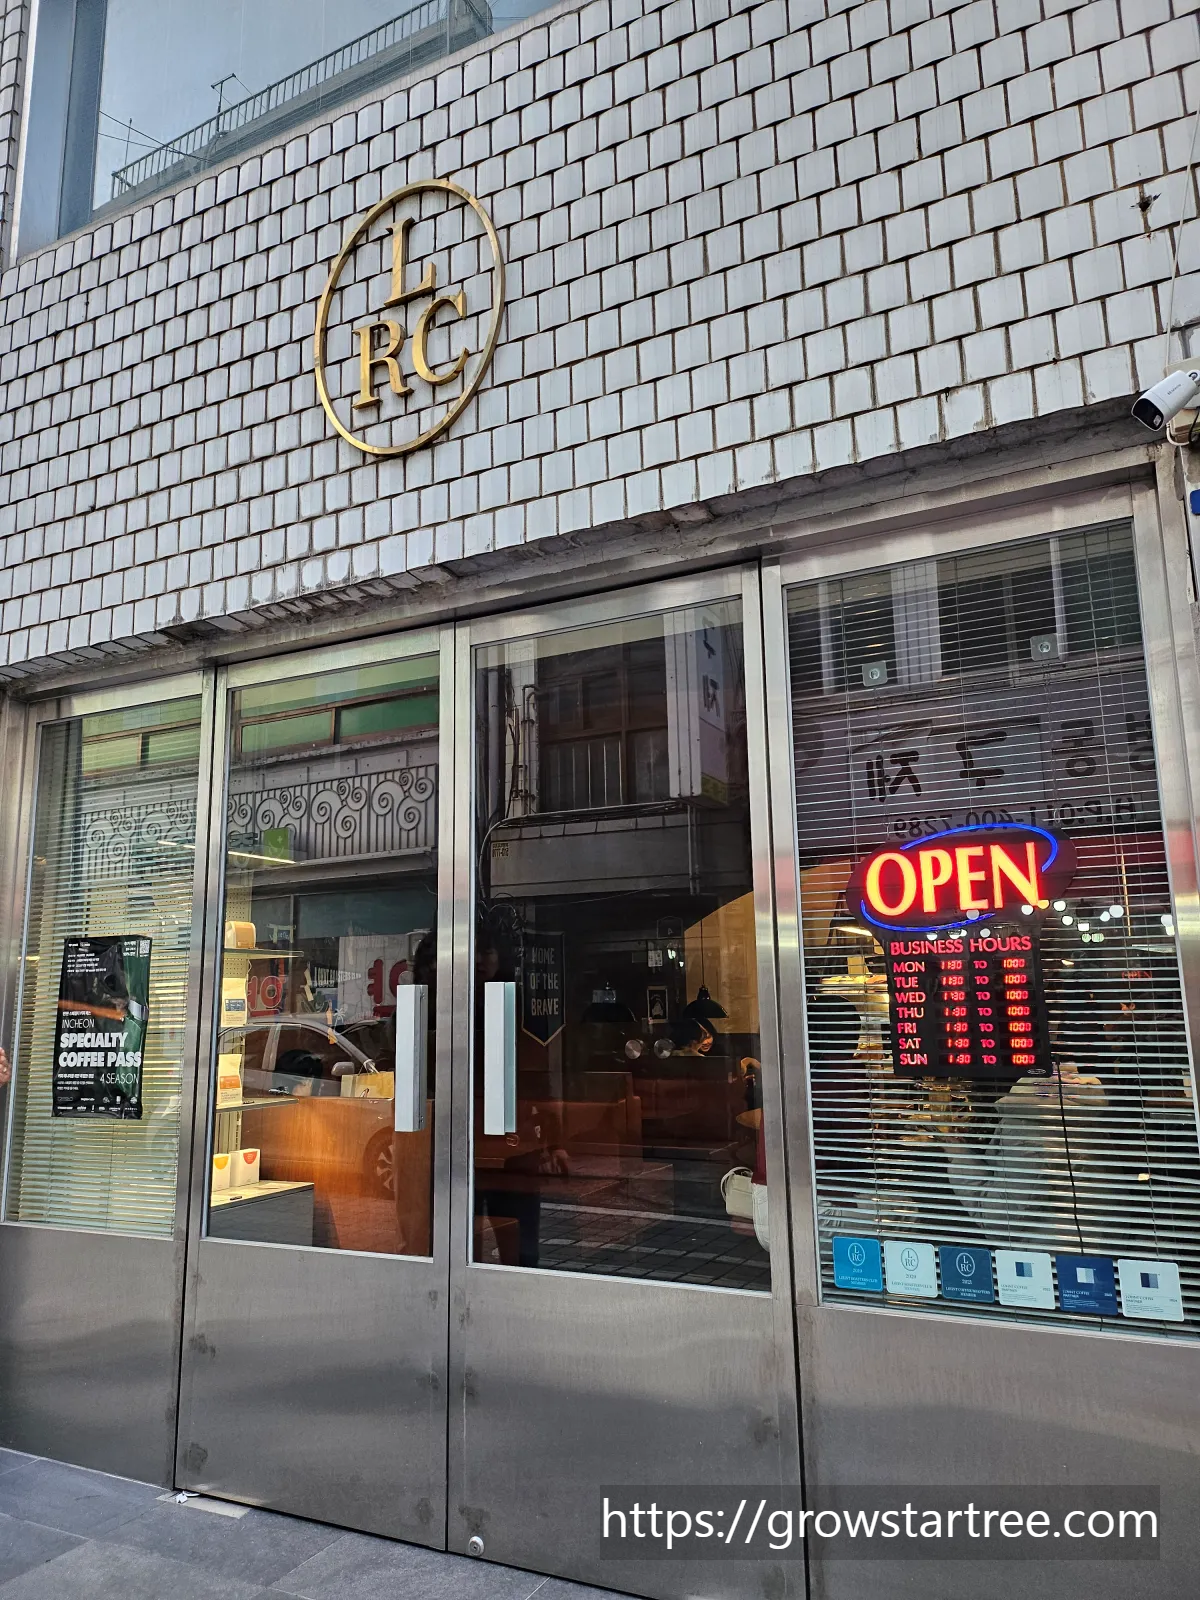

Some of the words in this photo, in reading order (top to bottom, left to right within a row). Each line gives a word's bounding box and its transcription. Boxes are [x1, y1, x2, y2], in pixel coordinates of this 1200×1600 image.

[384, 217, 436, 308] L
[351, 289, 469, 410] RC
[866, 841, 1038, 916] OPEN
[890, 939, 963, 956] BUSINESS
[970, 936, 1031, 953] HOURS
[893, 961, 925, 973] MON
[974, 961, 987, 969] TO
[543, 973, 559, 990] THE
[894, 976, 918, 988] TUE
[975, 976, 989, 985] TO
[895, 991, 926, 1004] WED
[976, 991, 990, 1000] TO
[532, 998, 559, 1016] BRAVE
[897, 1006, 924, 1019] THU
[978, 1007, 992, 1016] TO
[62, 1018, 94, 1029] INCHEON
[897, 1023, 917, 1034] FRI
[979, 1023, 993, 1032] TO
[60, 1032, 128, 1048] SPECIALTY
[899, 1038, 921, 1049] SAT
[981, 1039, 995, 1048] TO
[58, 1051, 104, 1067] COFFEE
[107, 1051, 141, 1067] PASS
[900, 1053, 927, 1065] SUN
[982, 1055, 997, 1064] TO
[100, 1073, 104, 1084] 4
[106, 1072, 138, 1084] SEASON
